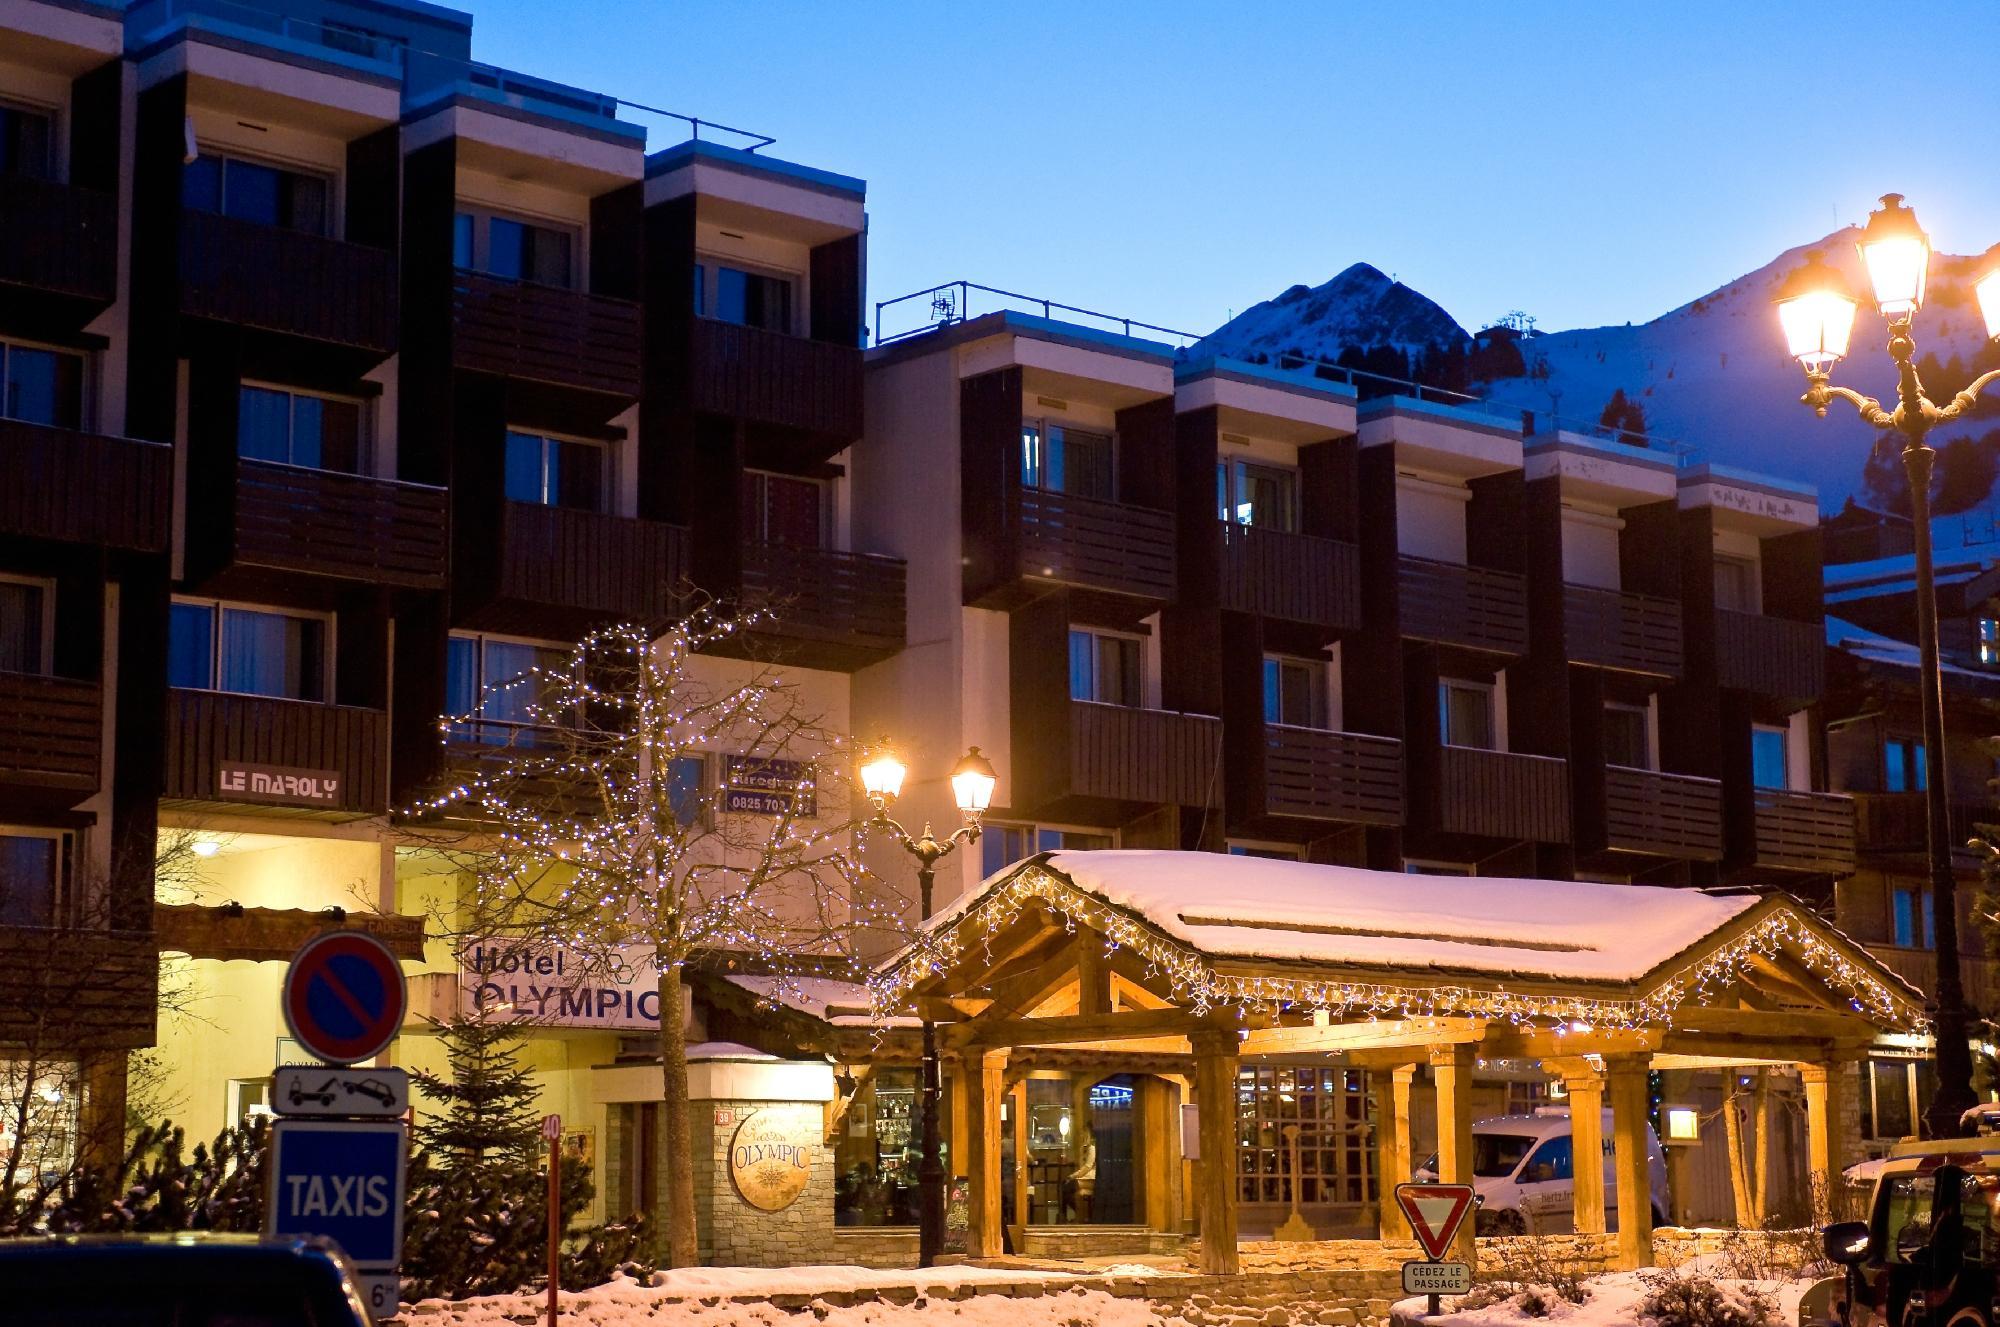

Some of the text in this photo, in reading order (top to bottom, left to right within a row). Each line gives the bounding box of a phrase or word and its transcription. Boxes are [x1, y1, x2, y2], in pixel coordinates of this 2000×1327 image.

[220, 770, 337, 799] LE MAROLY
[732, 796, 761, 809] 0825
[473, 982, 661, 1020] OLYMPIC
[543, 1115, 559, 1139] 40
[719, 1112, 729, 1123] 39
[735, 1144, 807, 1169] OLYMPIC
[286, 1175, 389, 1217] TAXIS
[1412, 1265, 1462, 1277] CÉDEZ LE
[1414, 1279, 1461, 1289] PASSAGE
